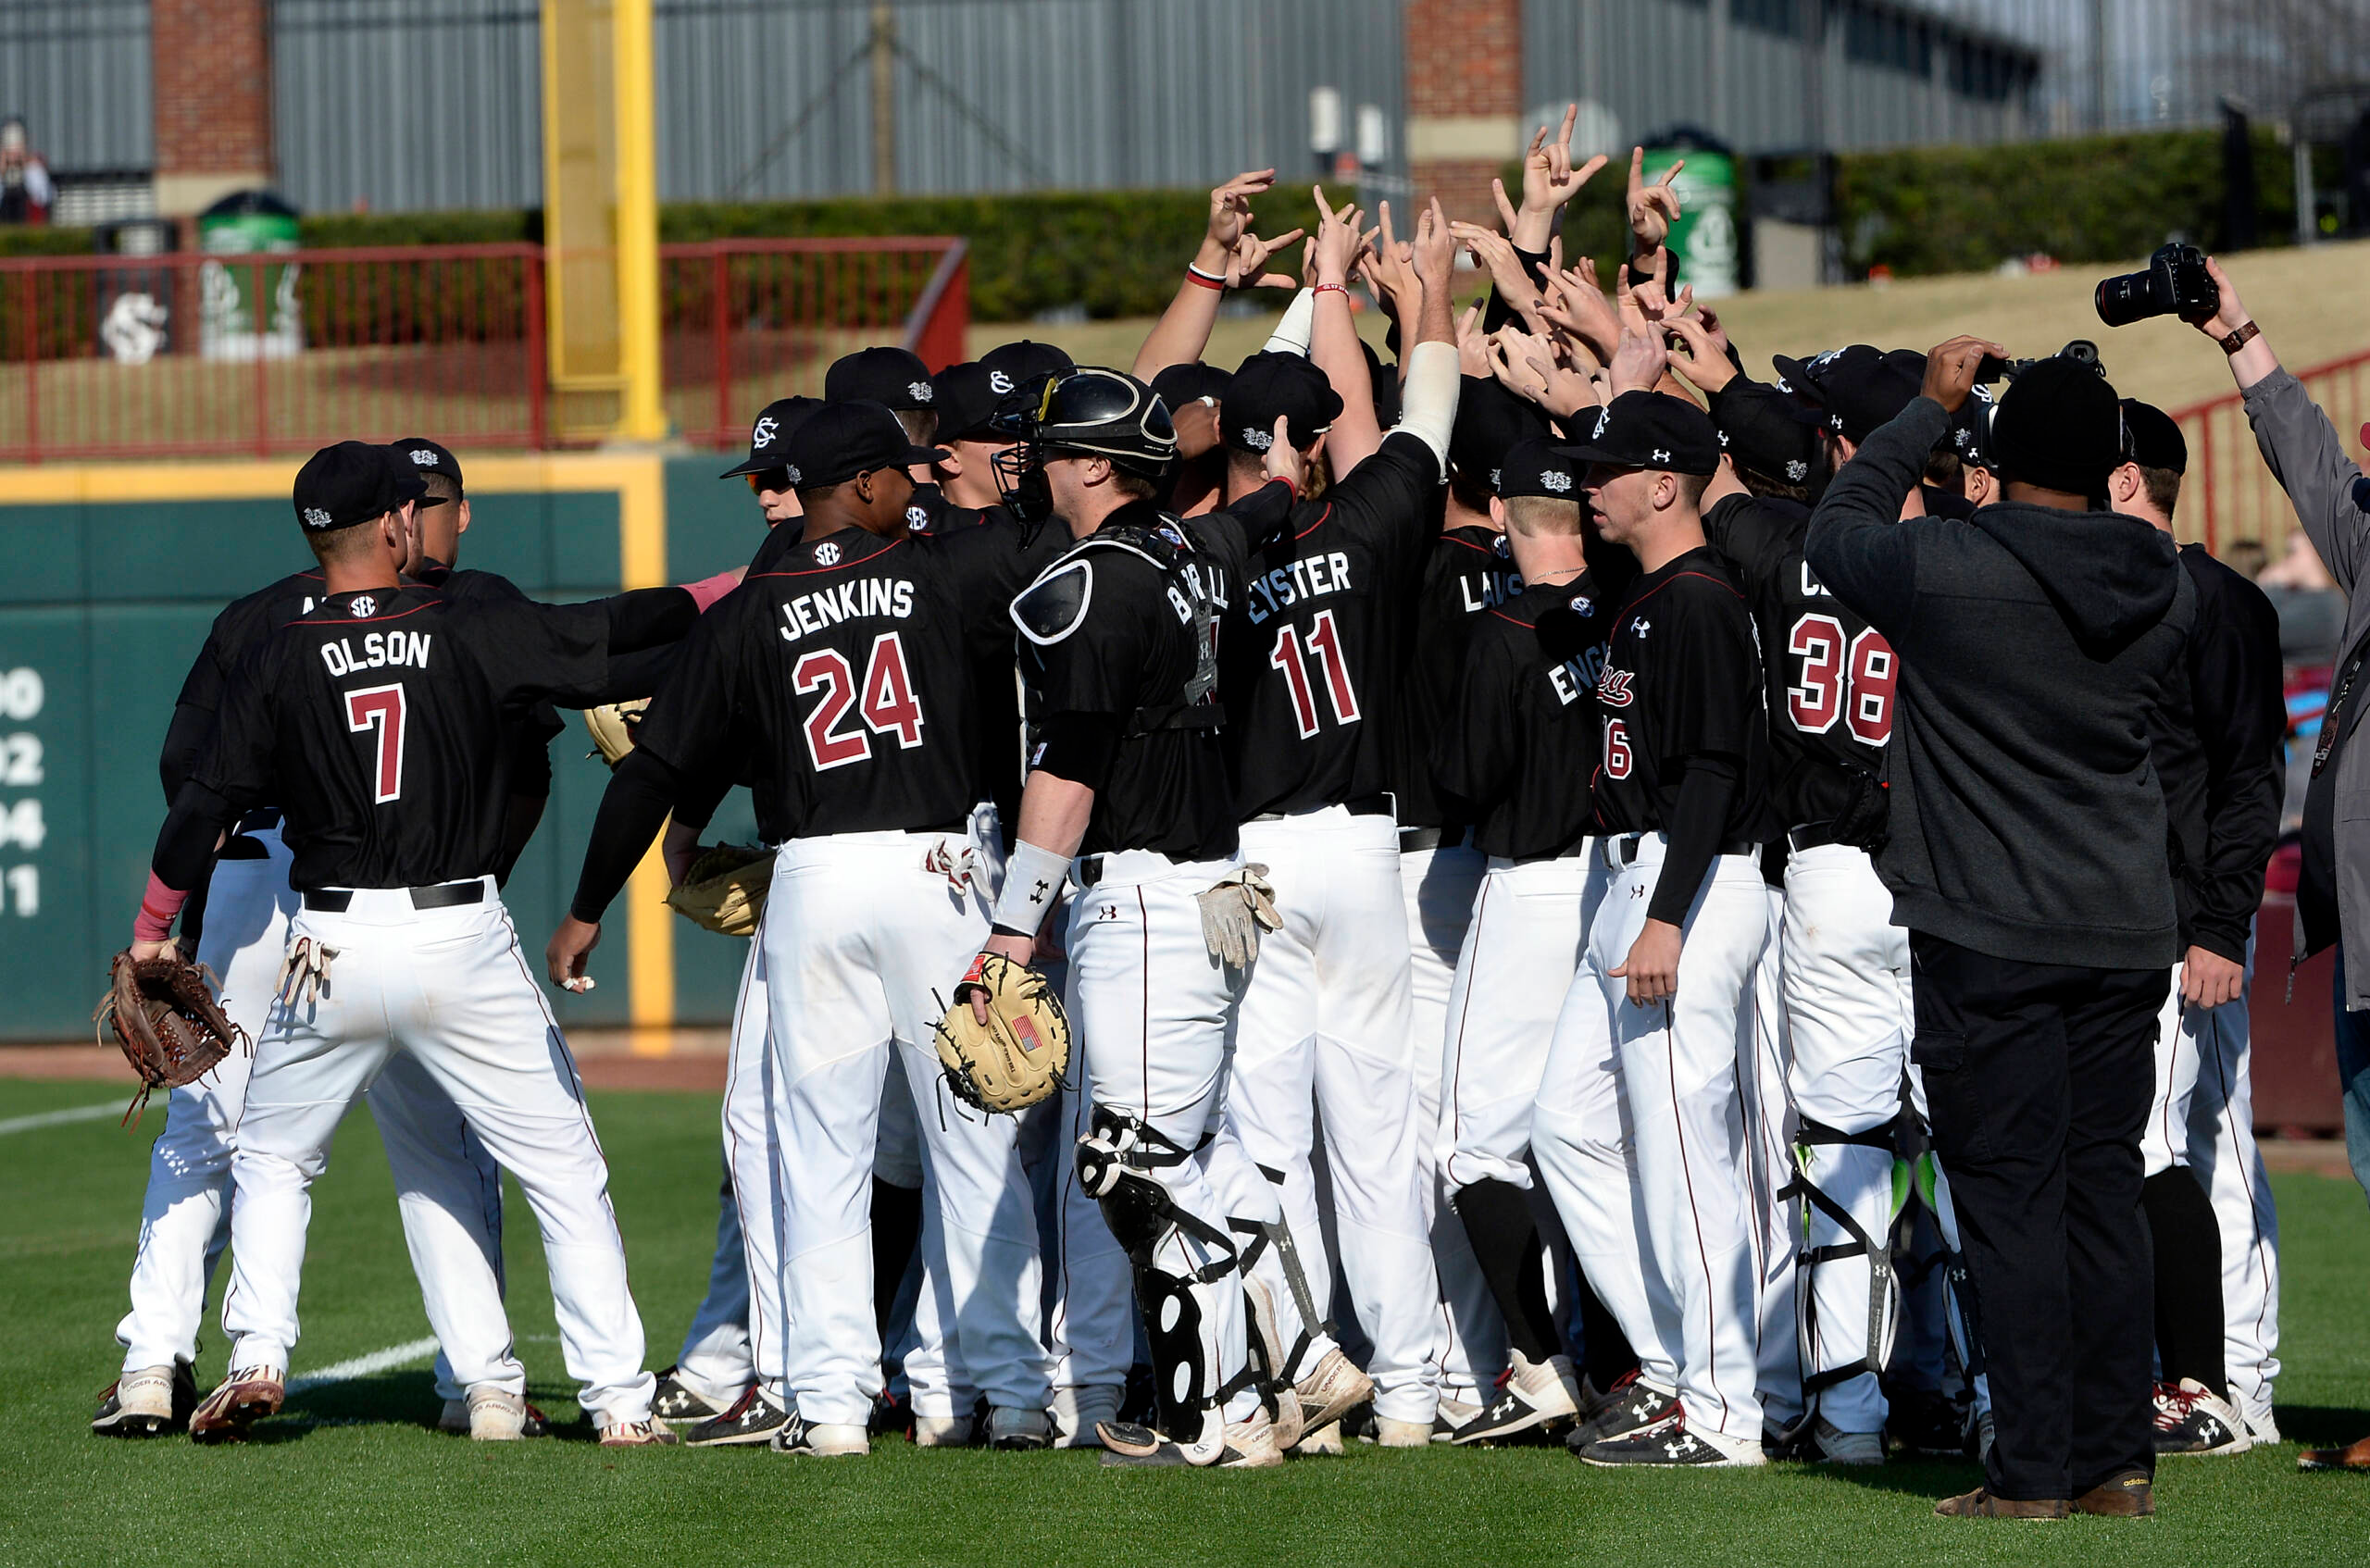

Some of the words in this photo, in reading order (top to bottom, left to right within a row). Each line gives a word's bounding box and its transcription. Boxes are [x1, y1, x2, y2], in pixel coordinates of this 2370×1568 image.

[814, 541, 842, 566] SEC
[349, 594, 376, 618] SEC
[780, 578, 915, 641] JENKINS
[320, 630, 431, 678] OLSON
[1268, 608, 1362, 740] 11
[1787, 612, 1901, 748] 38
[0, 666, 45, 721] 0
[791, 630, 925, 773] 24
[343, 681, 407, 805] 7
